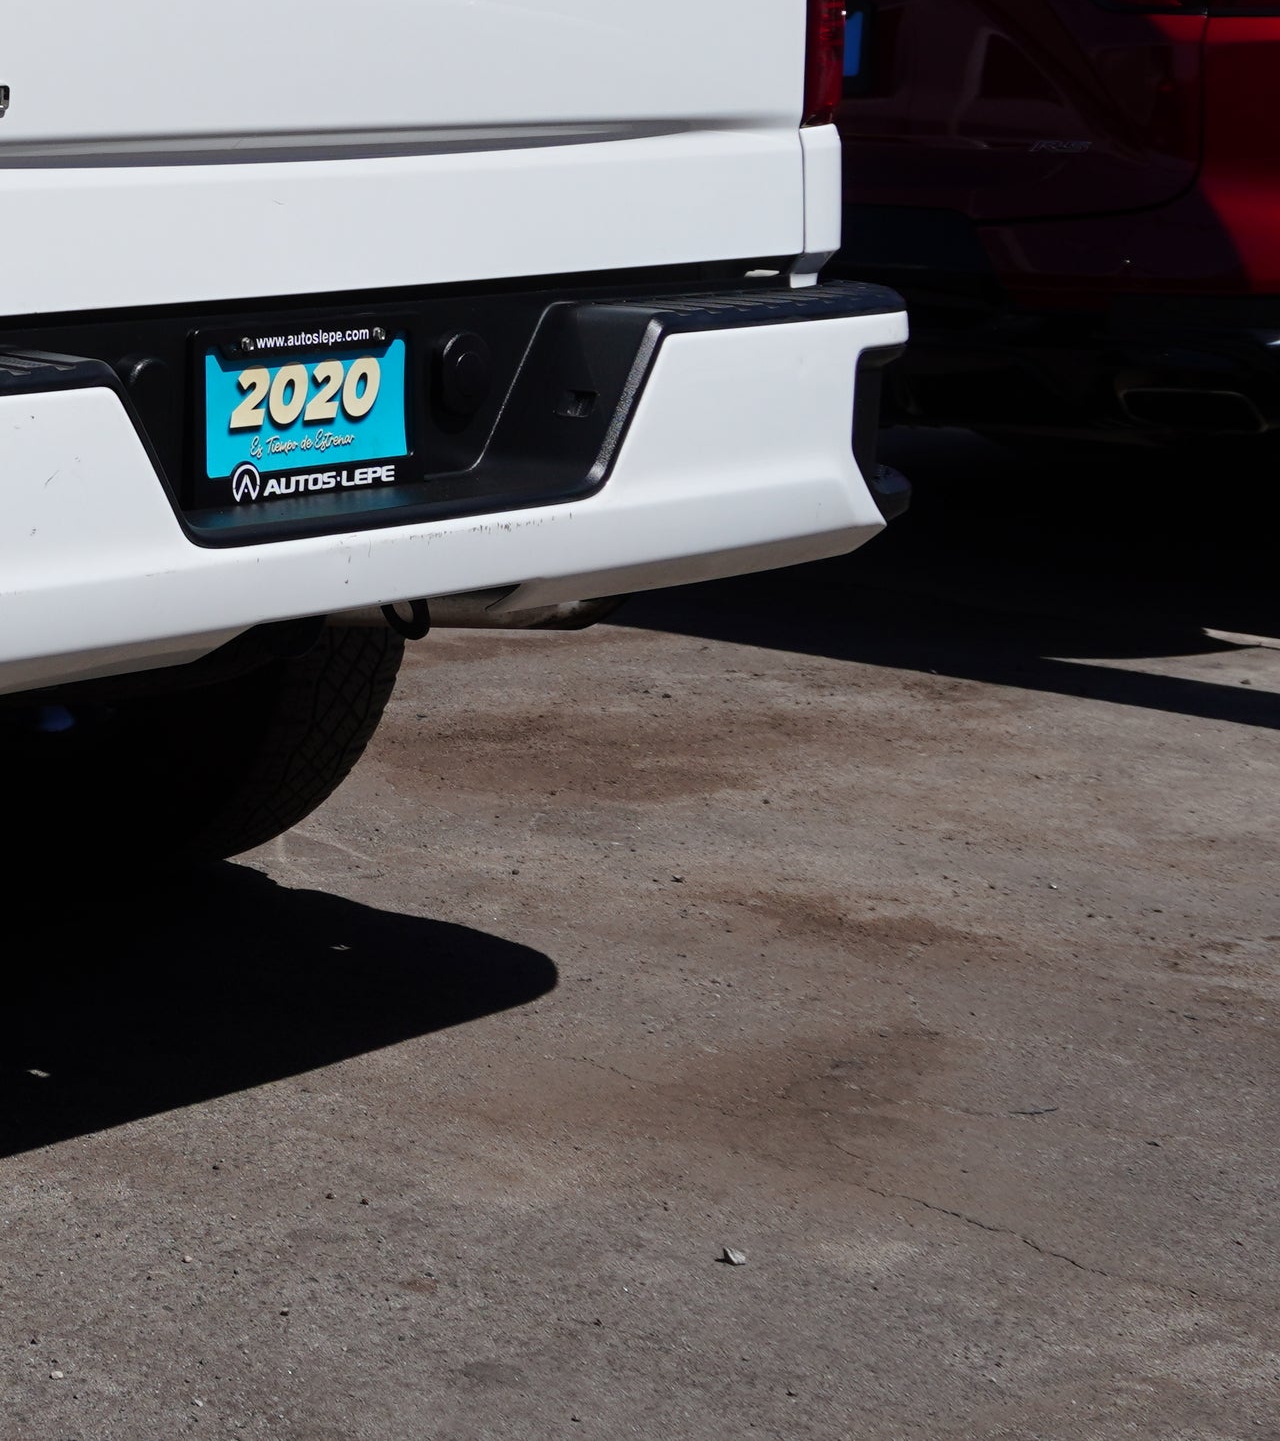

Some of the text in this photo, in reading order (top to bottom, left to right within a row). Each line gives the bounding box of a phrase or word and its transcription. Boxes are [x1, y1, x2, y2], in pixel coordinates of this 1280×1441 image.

[255, 326, 370, 350] www.autoslepe.com
[229, 355, 381, 431] 2020
[300, 431, 313, 449] de
